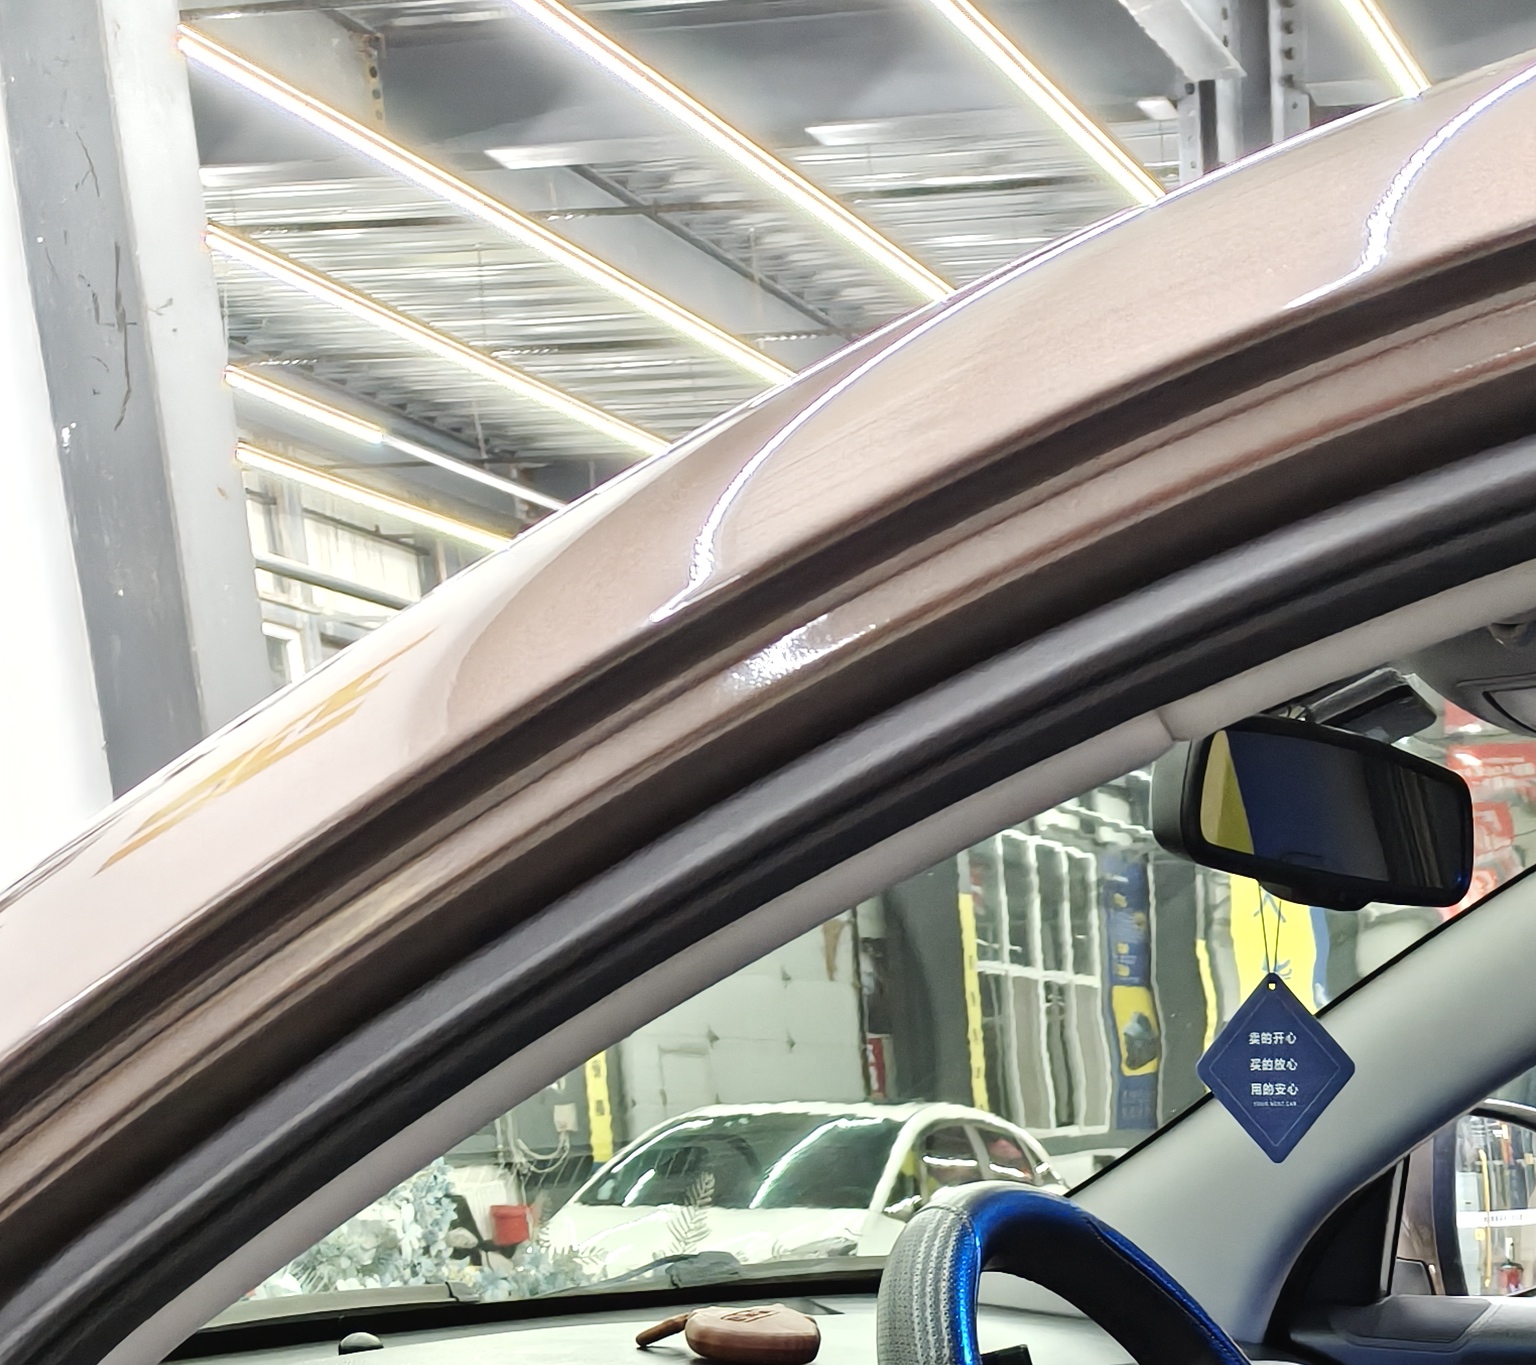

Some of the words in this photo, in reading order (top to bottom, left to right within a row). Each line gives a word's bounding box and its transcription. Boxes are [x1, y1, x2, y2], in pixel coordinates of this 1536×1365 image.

[1248, 1031, 1297, 1045] 卖的开心
[1249, 1057, 1298, 1071] 买的放心
[1250, 1082, 1299, 1096] 用的安心
